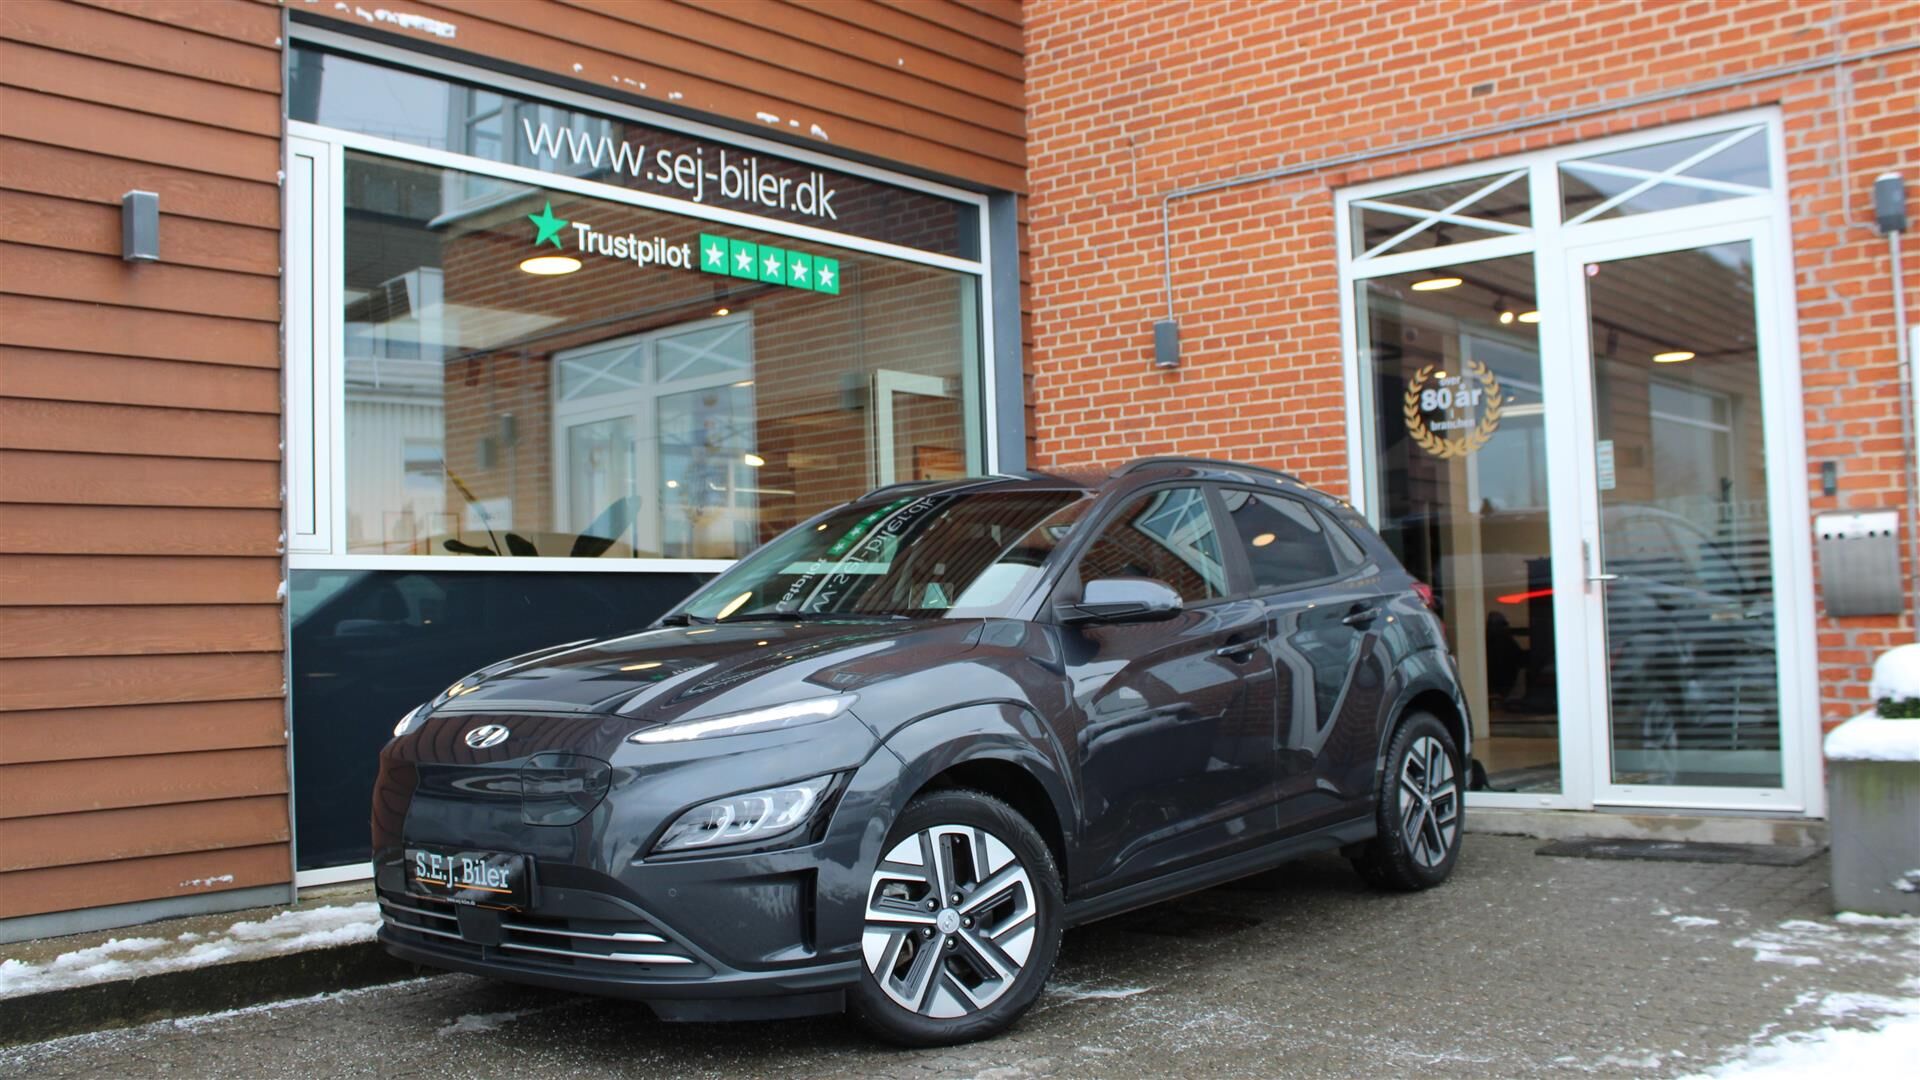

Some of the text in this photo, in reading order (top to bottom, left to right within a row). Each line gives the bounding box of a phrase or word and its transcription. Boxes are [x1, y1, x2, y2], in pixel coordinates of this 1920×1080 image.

[523, 118, 837, 220] www.sej-biler.dk
[572, 221, 691, 269] Trustpilot
[1421, 384, 1481, 411] 80 år
[415, 852, 509, 888] S.E.J. Biler
